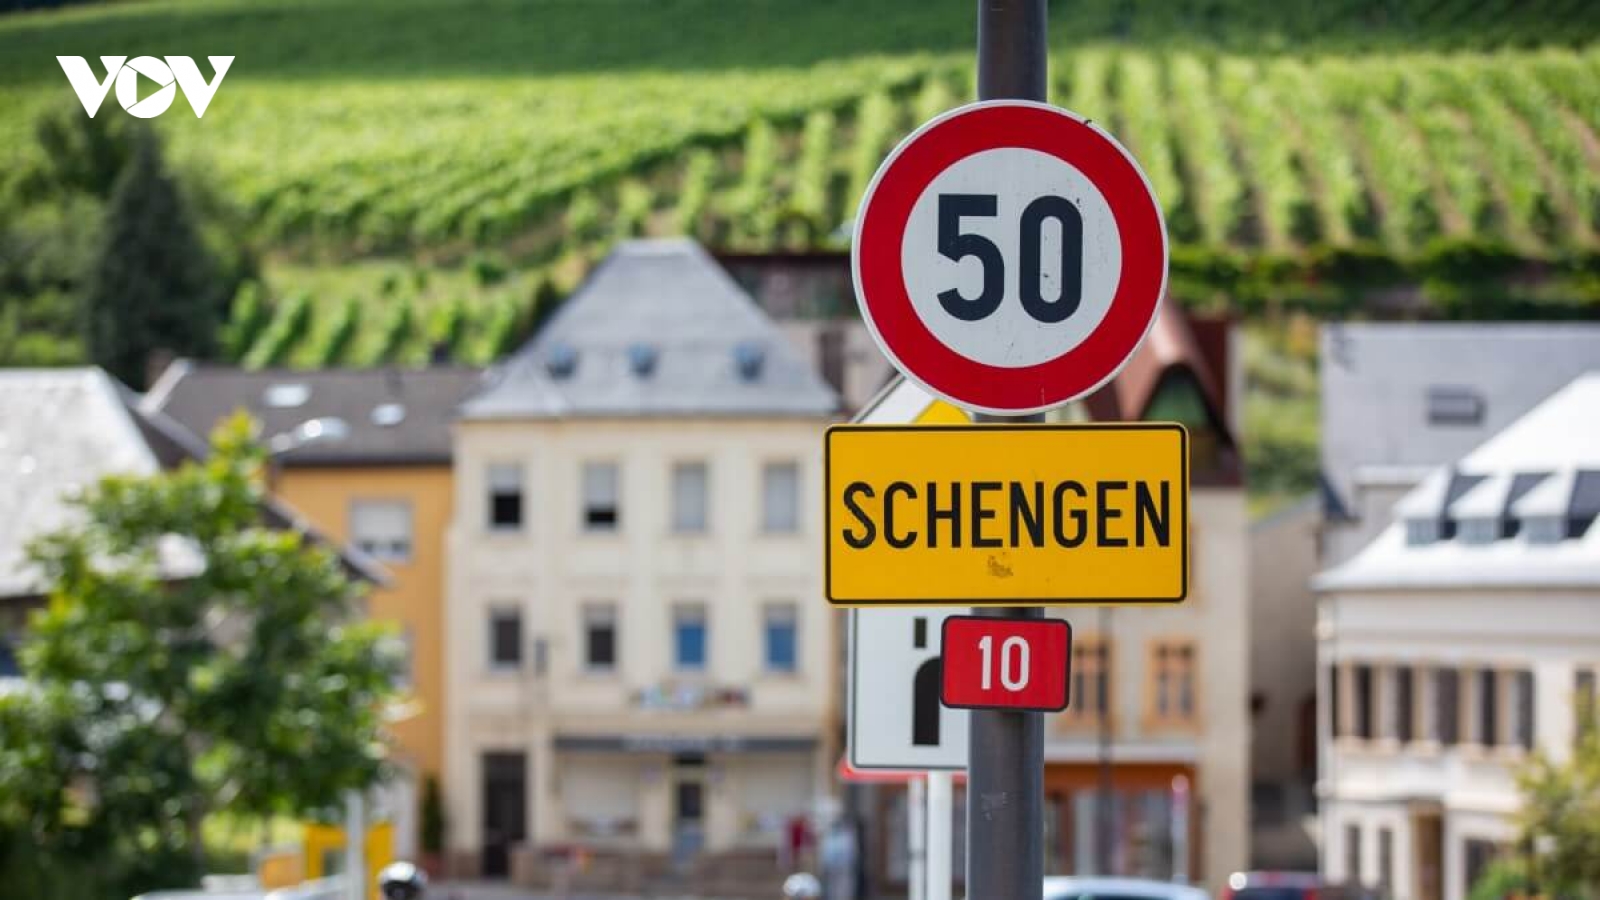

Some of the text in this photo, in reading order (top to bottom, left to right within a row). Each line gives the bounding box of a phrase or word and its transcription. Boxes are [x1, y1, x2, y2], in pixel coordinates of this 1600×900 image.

[936, 194, 1083, 324] 50
[842, 480, 1170, 549] SCHENGEN
[978, 635, 1030, 692] 10
